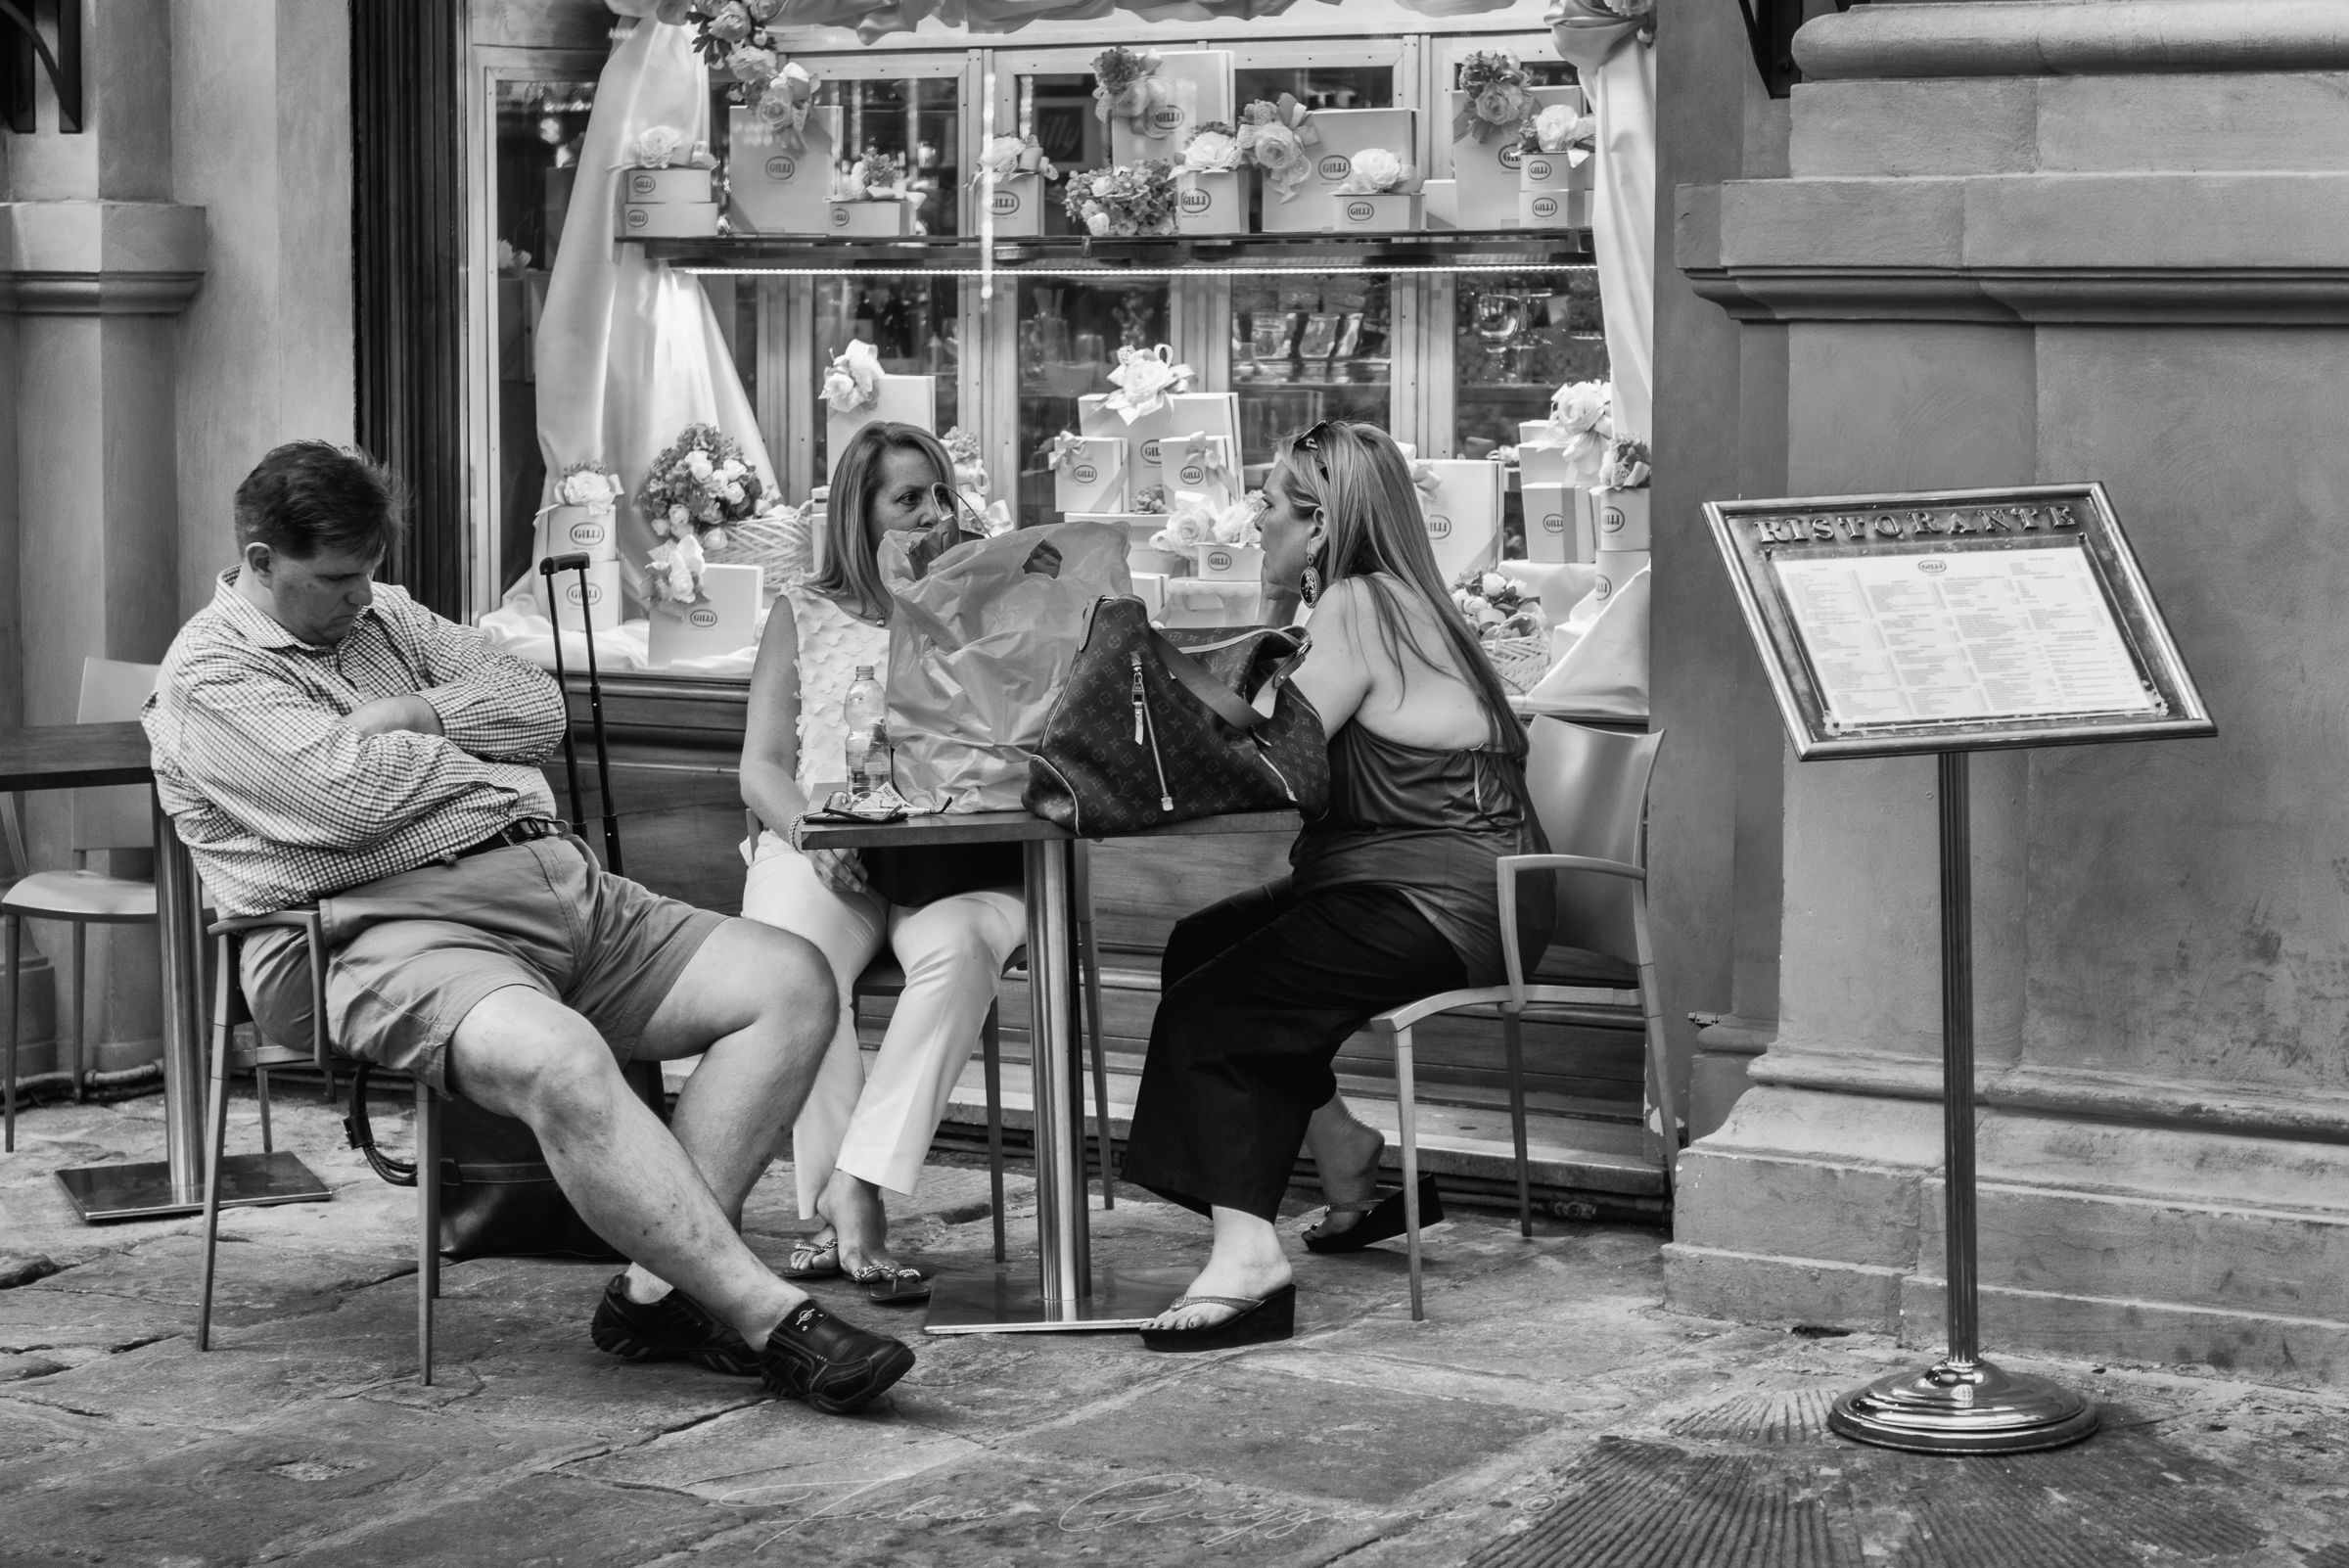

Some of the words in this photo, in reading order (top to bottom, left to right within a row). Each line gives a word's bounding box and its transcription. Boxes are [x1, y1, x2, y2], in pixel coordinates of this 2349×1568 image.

[1155, 112, 1179, 122] GILLI
[769, 162, 791, 173] GILLI
[1322, 162, 1347, 173] GILLI
[1530, 165, 1548, 174] GILLI
[1182, 196, 1206, 206] GILLI
[1350, 207, 1370, 215] GILLI
[1535, 203, 1553, 211] GILLI
[1144, 446, 1160, 457] GIL
[1183, 471, 1200, 480] GILLI
[1429, 522, 1447, 532] ILLI
[1753, 505, 2077, 544] RISTORANTE
[574, 530, 600, 539] GILLI
[1210, 557, 1228, 566] GILLI
[571, 589, 597, 599] GILI
